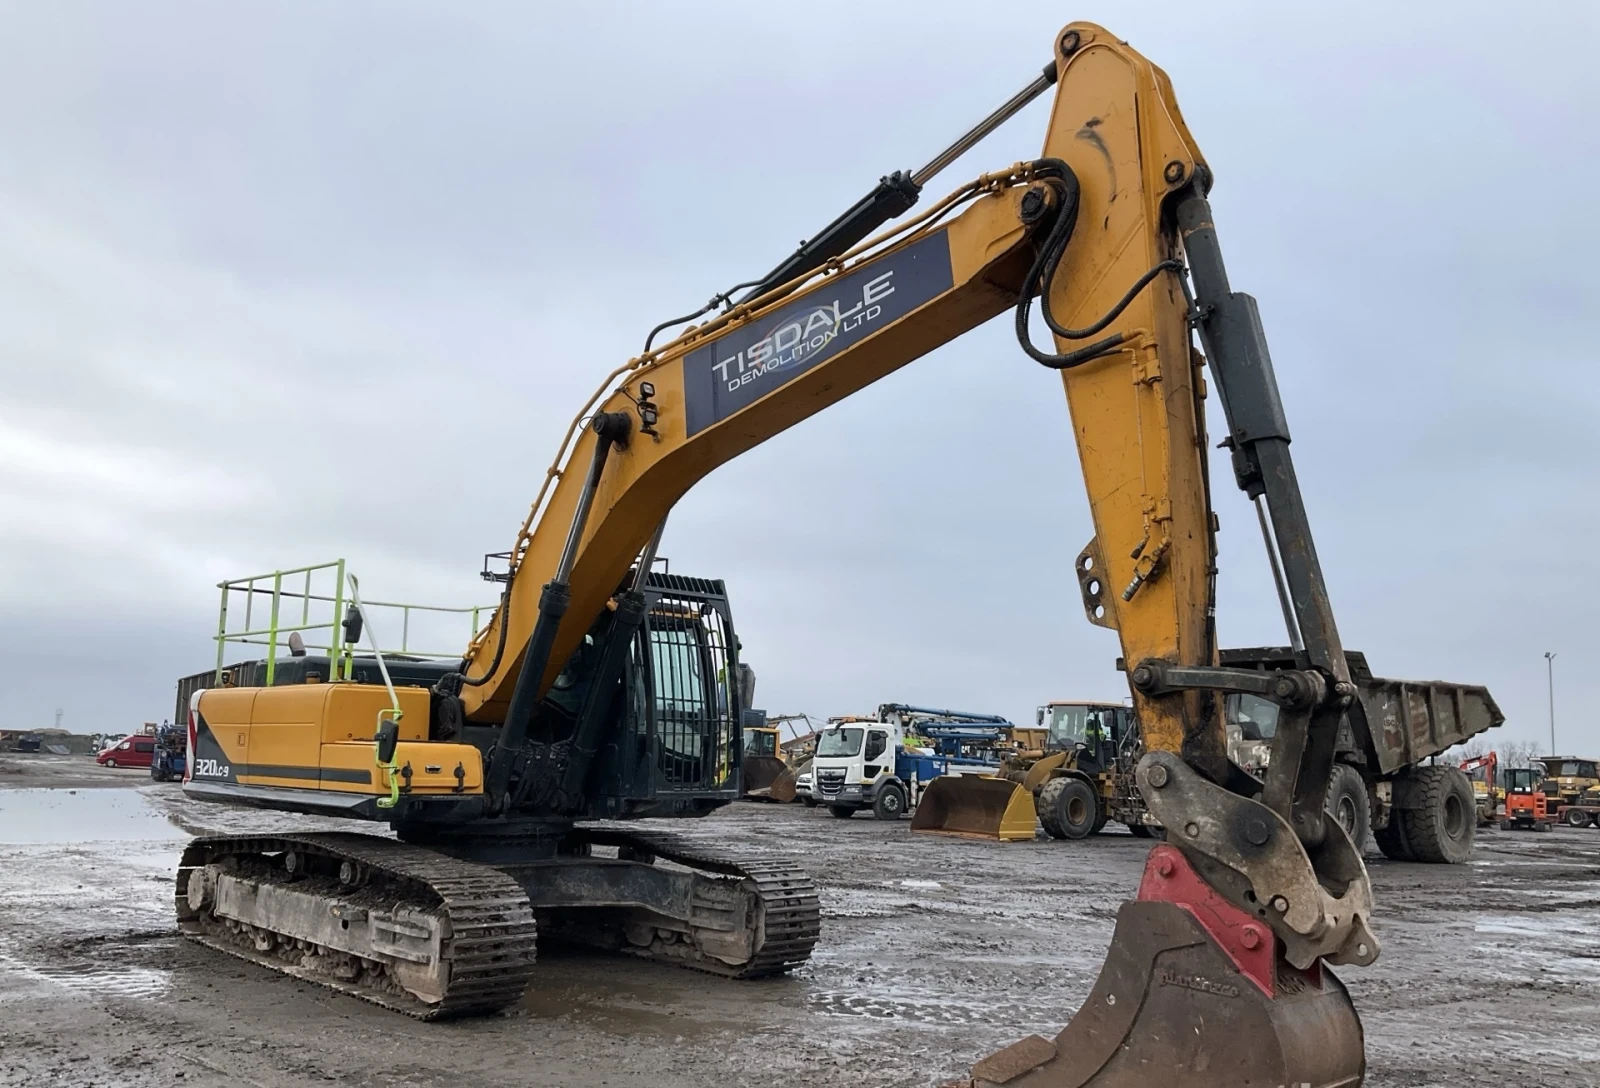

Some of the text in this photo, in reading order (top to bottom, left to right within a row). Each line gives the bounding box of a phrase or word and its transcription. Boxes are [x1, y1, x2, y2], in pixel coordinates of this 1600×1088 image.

[711, 269, 896, 383] TISDALE
[727, 304, 882, 392] DEMOLITION LTD
